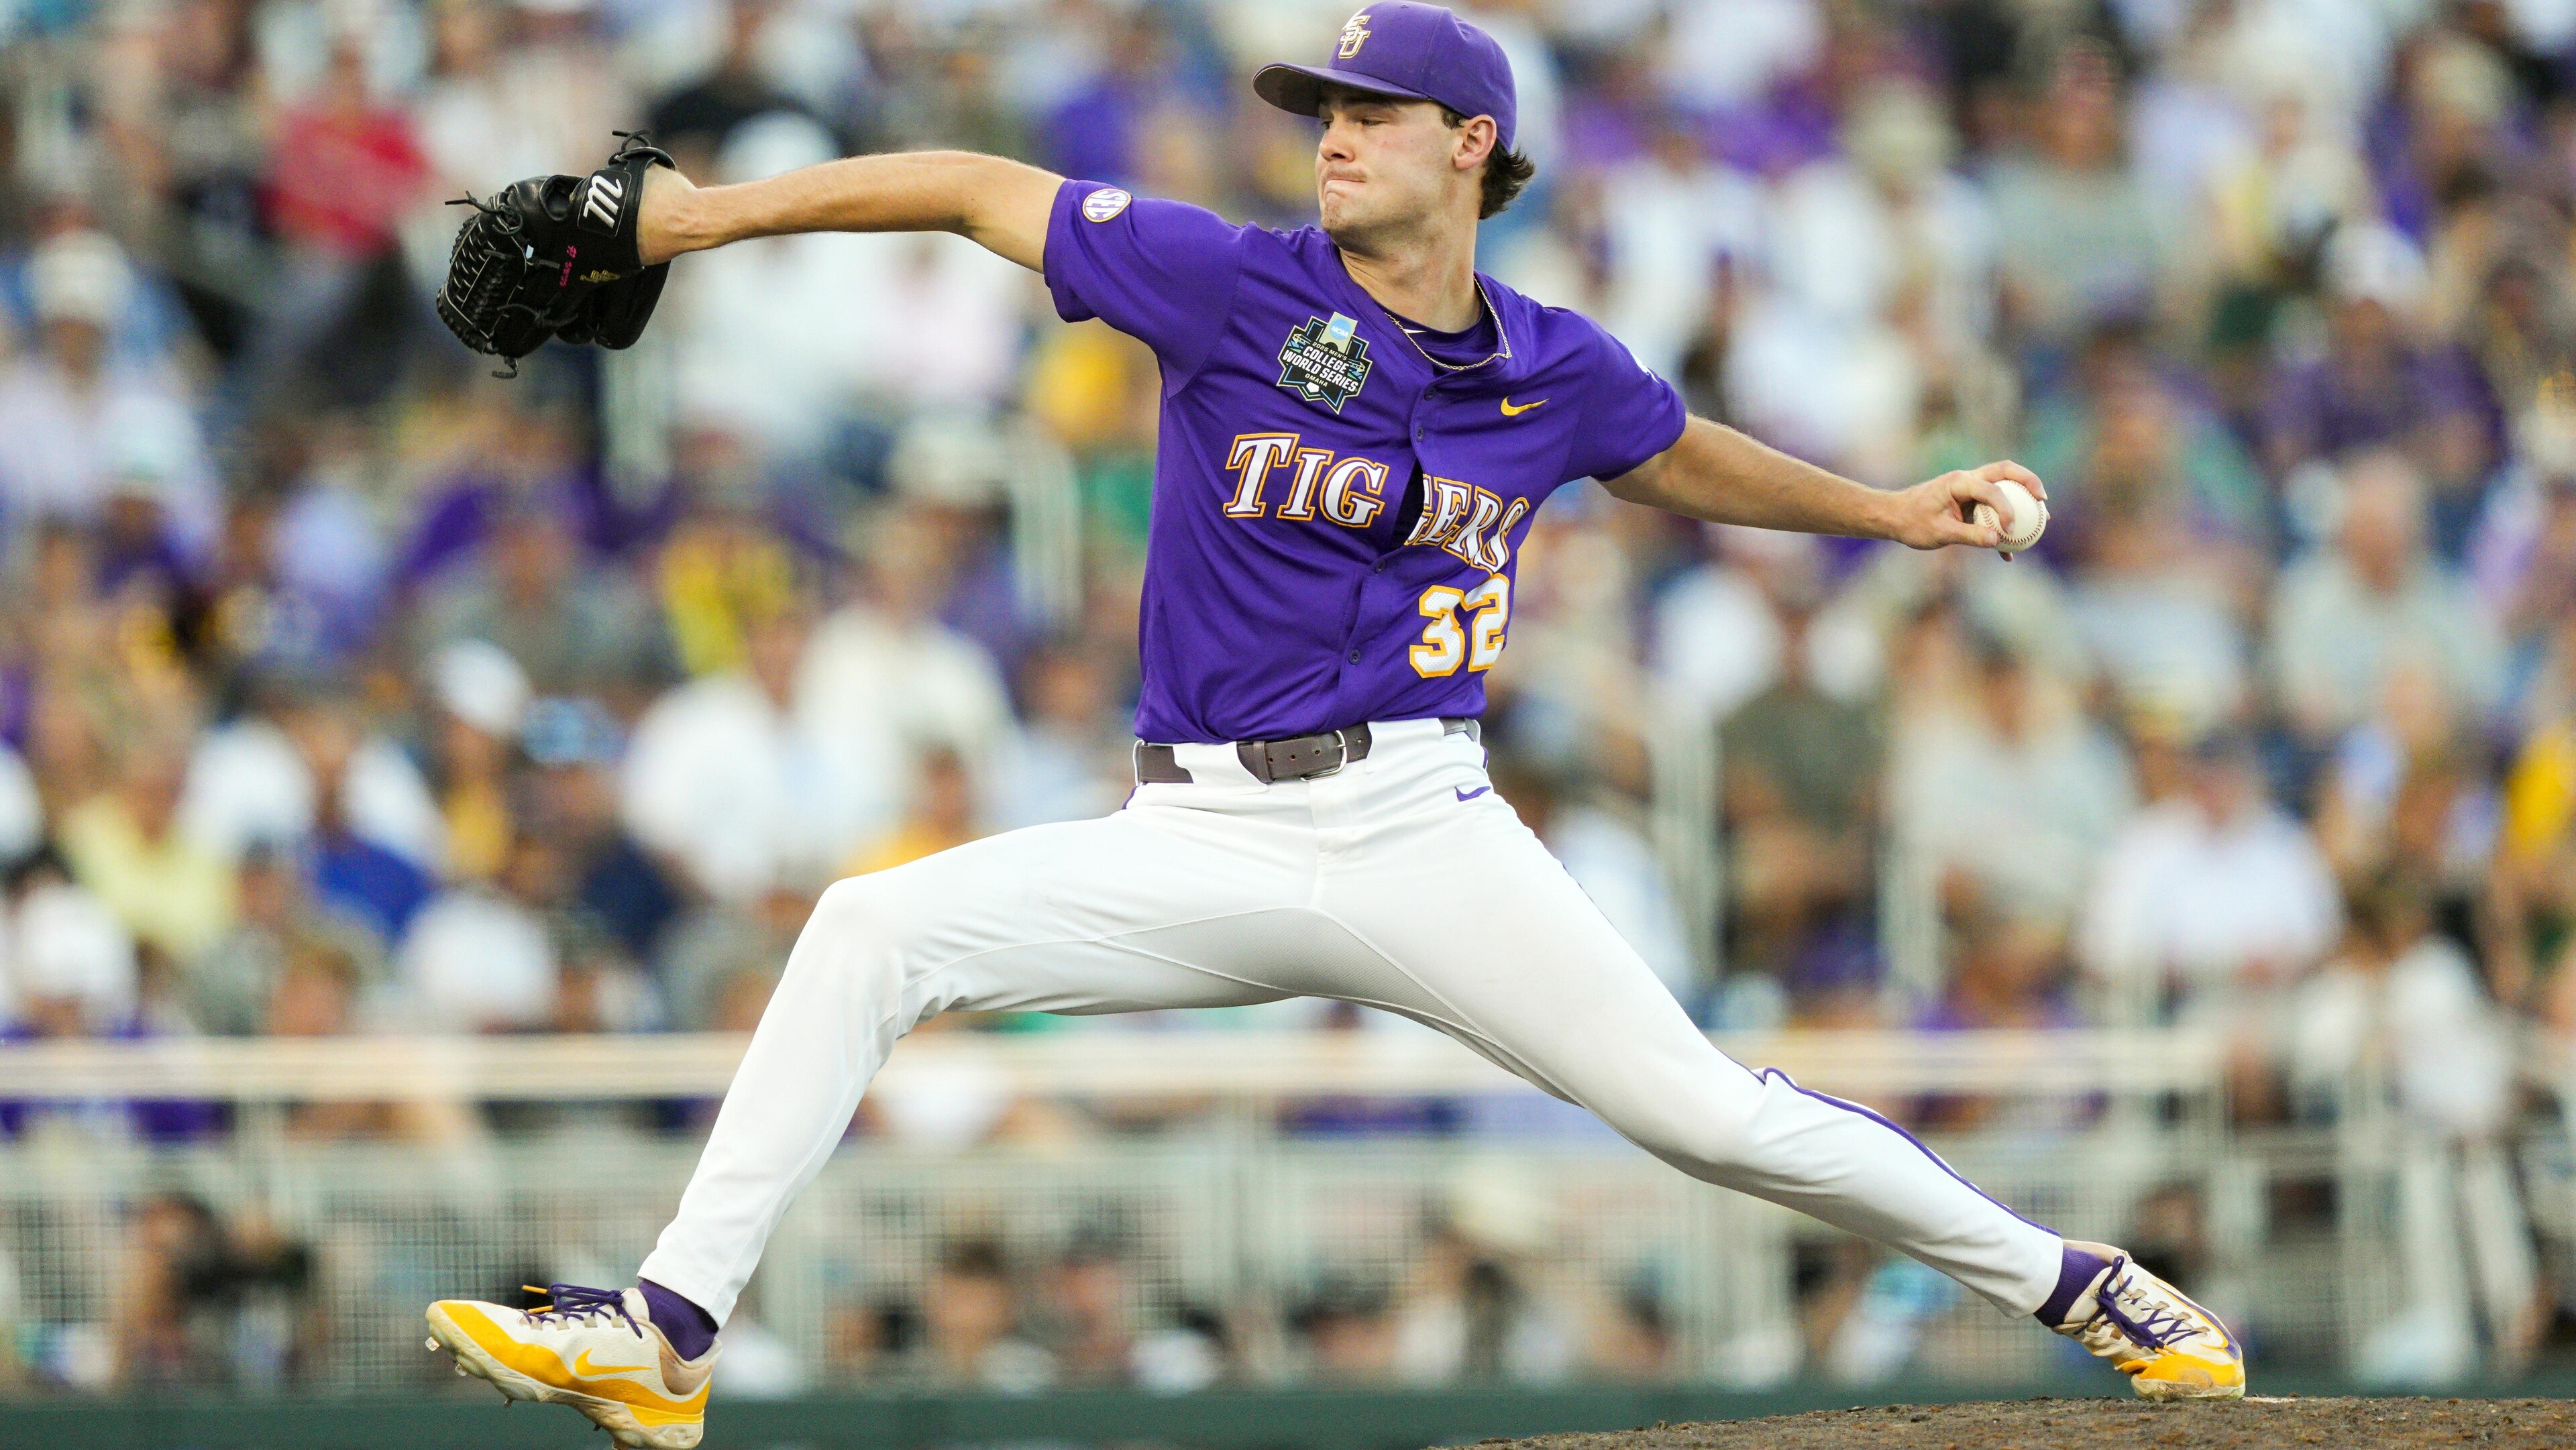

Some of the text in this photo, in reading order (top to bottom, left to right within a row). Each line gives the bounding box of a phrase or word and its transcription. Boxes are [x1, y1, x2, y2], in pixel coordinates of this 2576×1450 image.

[1085, 190, 1128, 219] SEC
[1330, 325, 1349, 338] NCAA
[1302, 345, 1350, 374] COLLEGE
[1311, 341, 1348, 361] 2025 MEN'S
[1282, 349, 1359, 392] WORLD SERIES
[1304, 373, 1329, 388] OMAHA
[1409, 572, 1510, 679] 32
